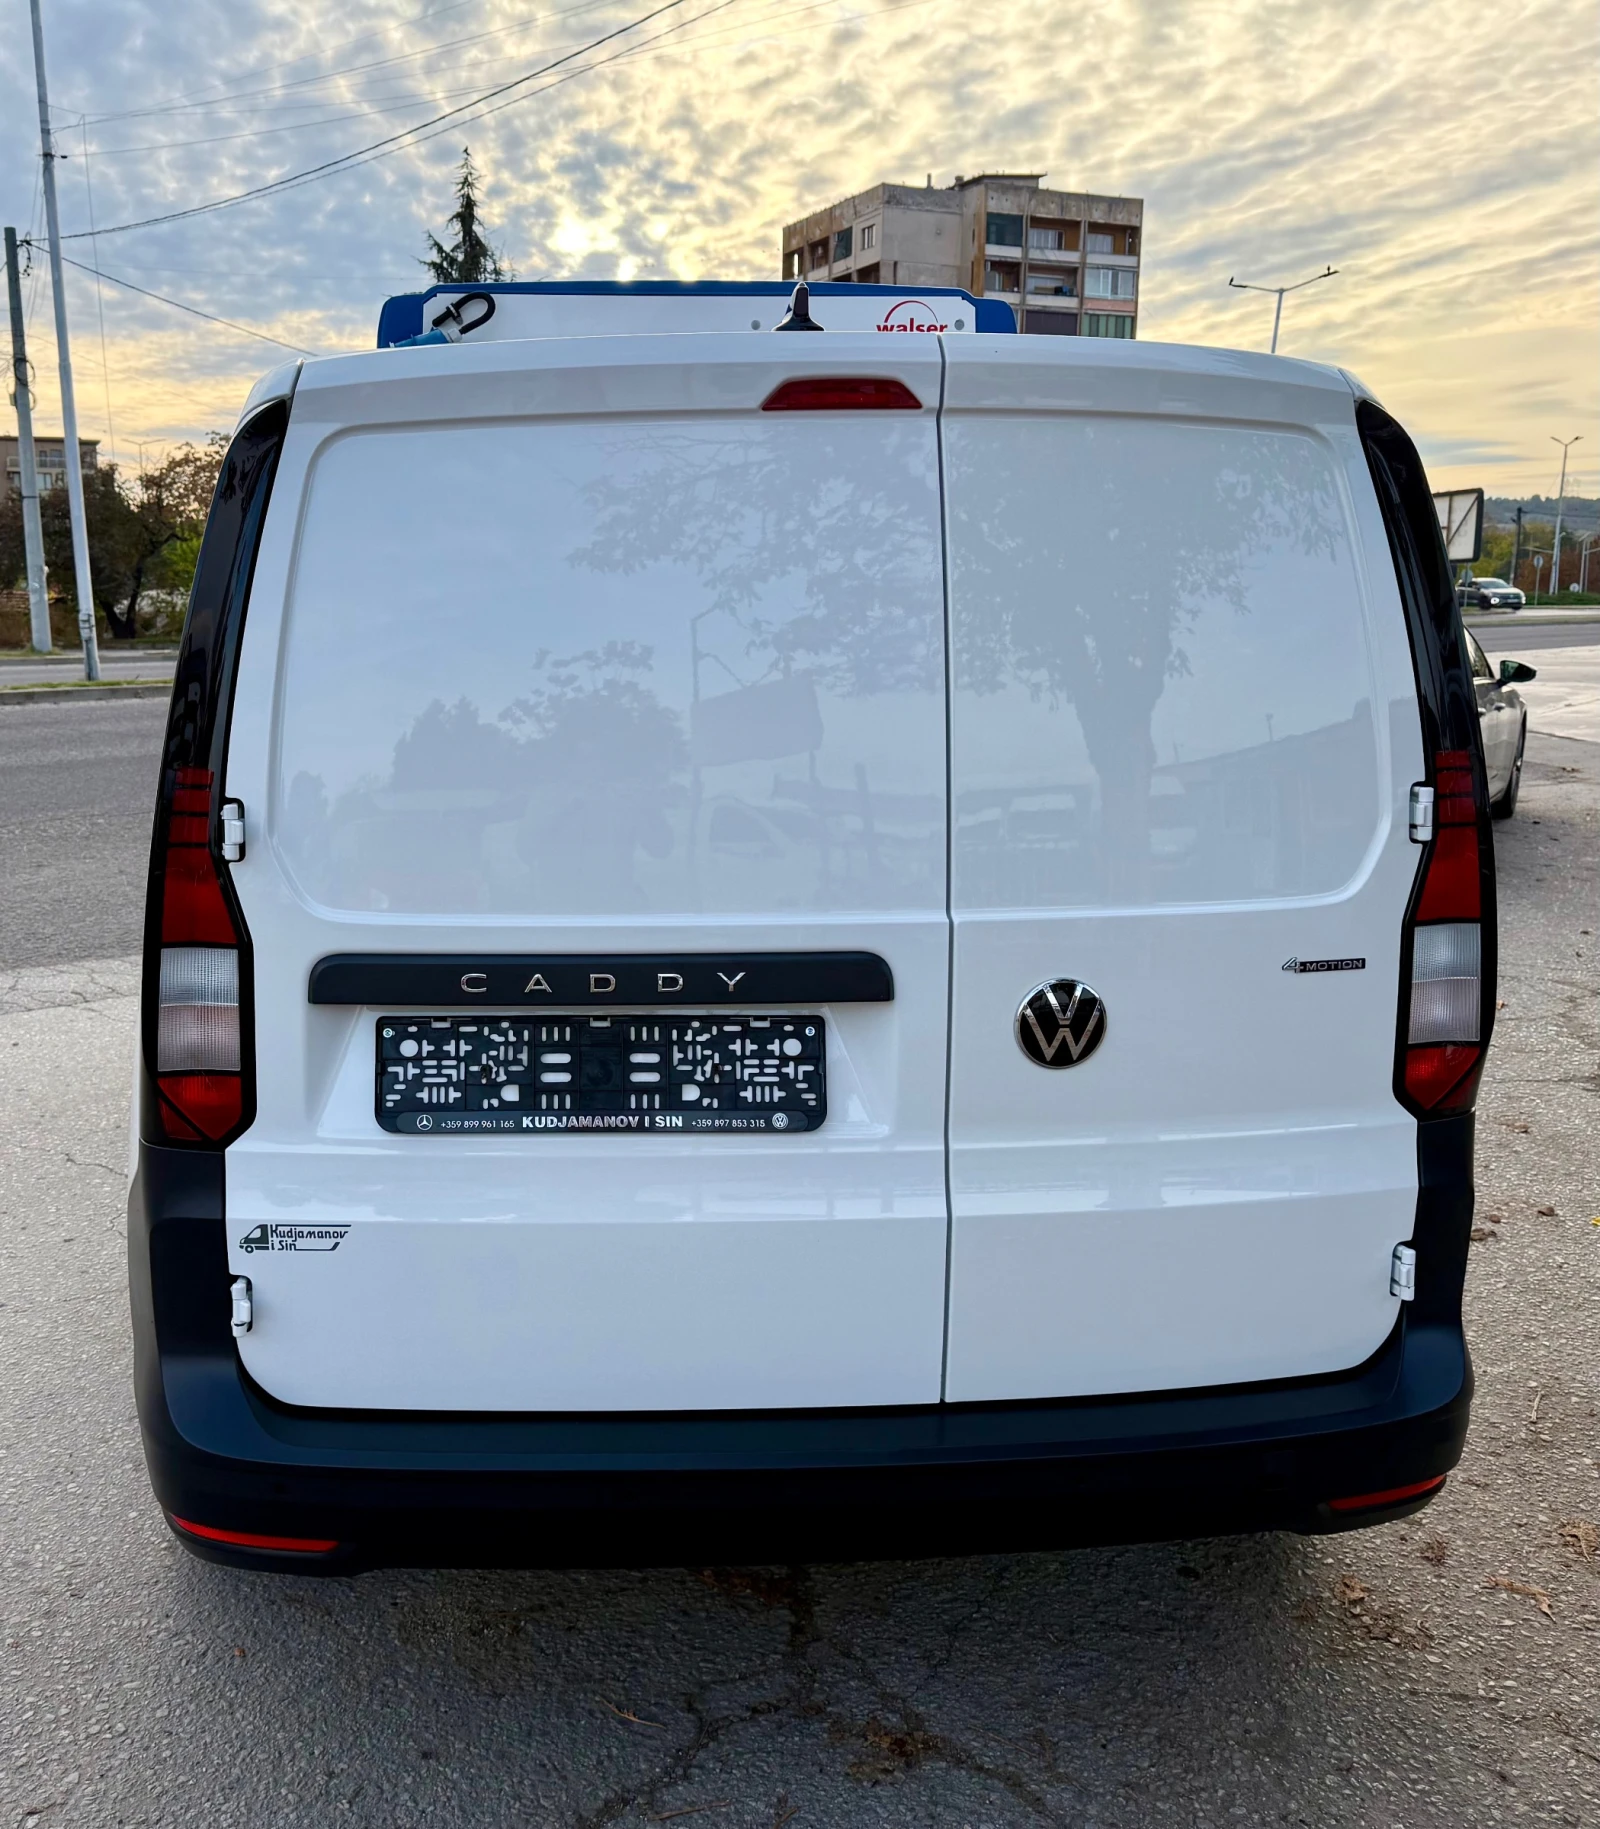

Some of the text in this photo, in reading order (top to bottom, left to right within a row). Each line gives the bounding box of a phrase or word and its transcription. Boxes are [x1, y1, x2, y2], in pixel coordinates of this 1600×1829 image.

[876, 317, 948, 332] walser
[460, 972, 746, 993] CADDY
[440, 1119, 515, 1128] +359 899 961 165
[522, 1115, 683, 1128] KUDJAMANOV I SIN
[691, 1118, 766, 1128] +359 897 853 315
[270, 1224, 349, 1242] Kudjamanov
[277, 1240, 297, 1251] Sin
